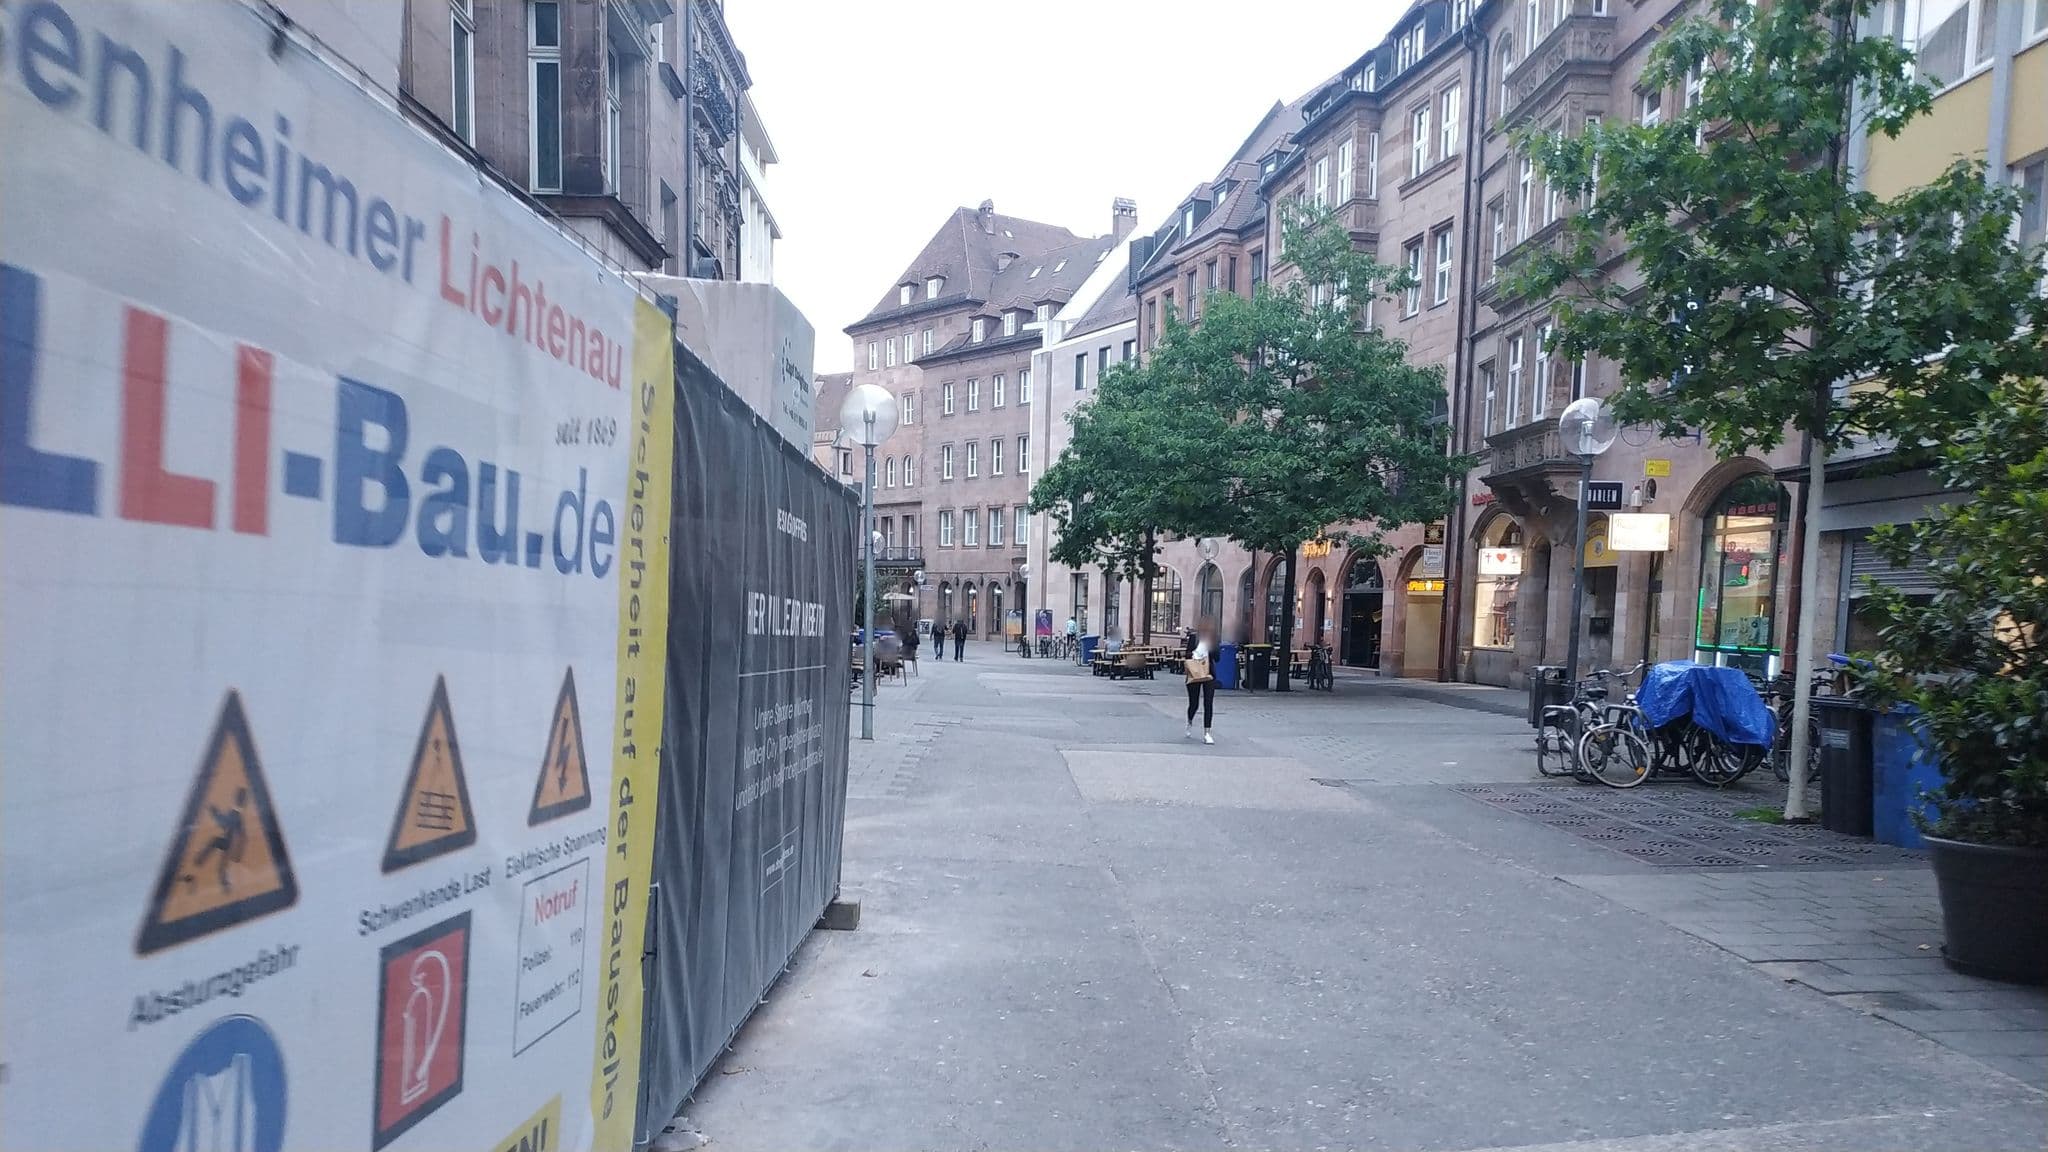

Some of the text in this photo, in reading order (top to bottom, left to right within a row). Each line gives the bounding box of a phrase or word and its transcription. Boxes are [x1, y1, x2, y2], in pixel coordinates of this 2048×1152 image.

[0, 0, 622, 390] enheimer Lichtenau
[534, 880, 578, 926] Notruf
[602, 382, 656, 1120] Sicherheit auf der Baustelle
